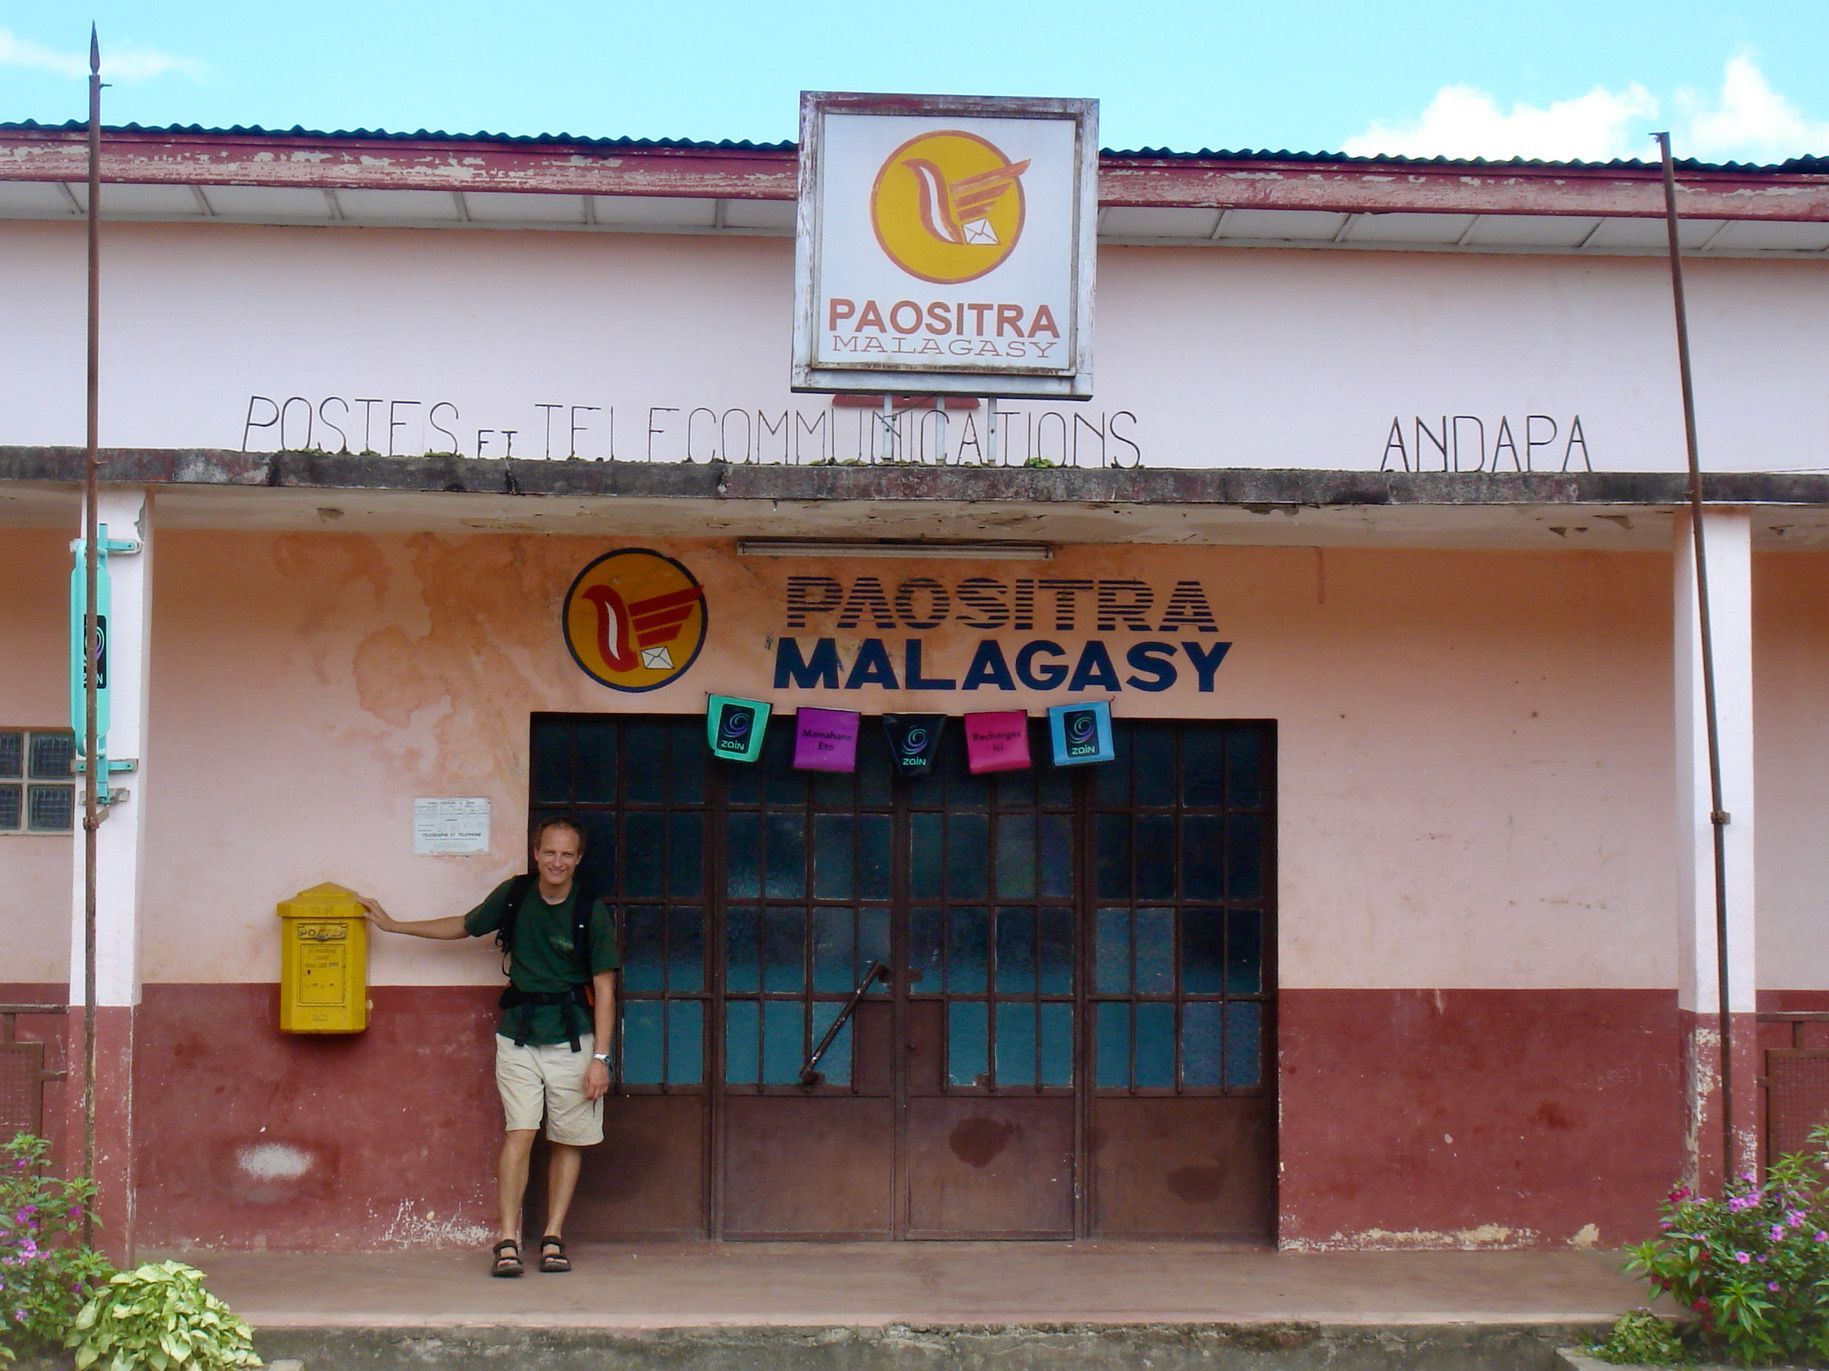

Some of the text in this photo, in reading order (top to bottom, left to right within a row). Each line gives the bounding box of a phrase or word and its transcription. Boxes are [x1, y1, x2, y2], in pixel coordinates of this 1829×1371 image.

[828, 297, 1061, 339] PAOSITRA
[832, 335, 1058, 358] MALAGASY
[1380, 414, 1592, 473] ANDAPA
[787, 576, 1219, 632] PAOSITRA
[773, 637, 1233, 692] MALAGASY
